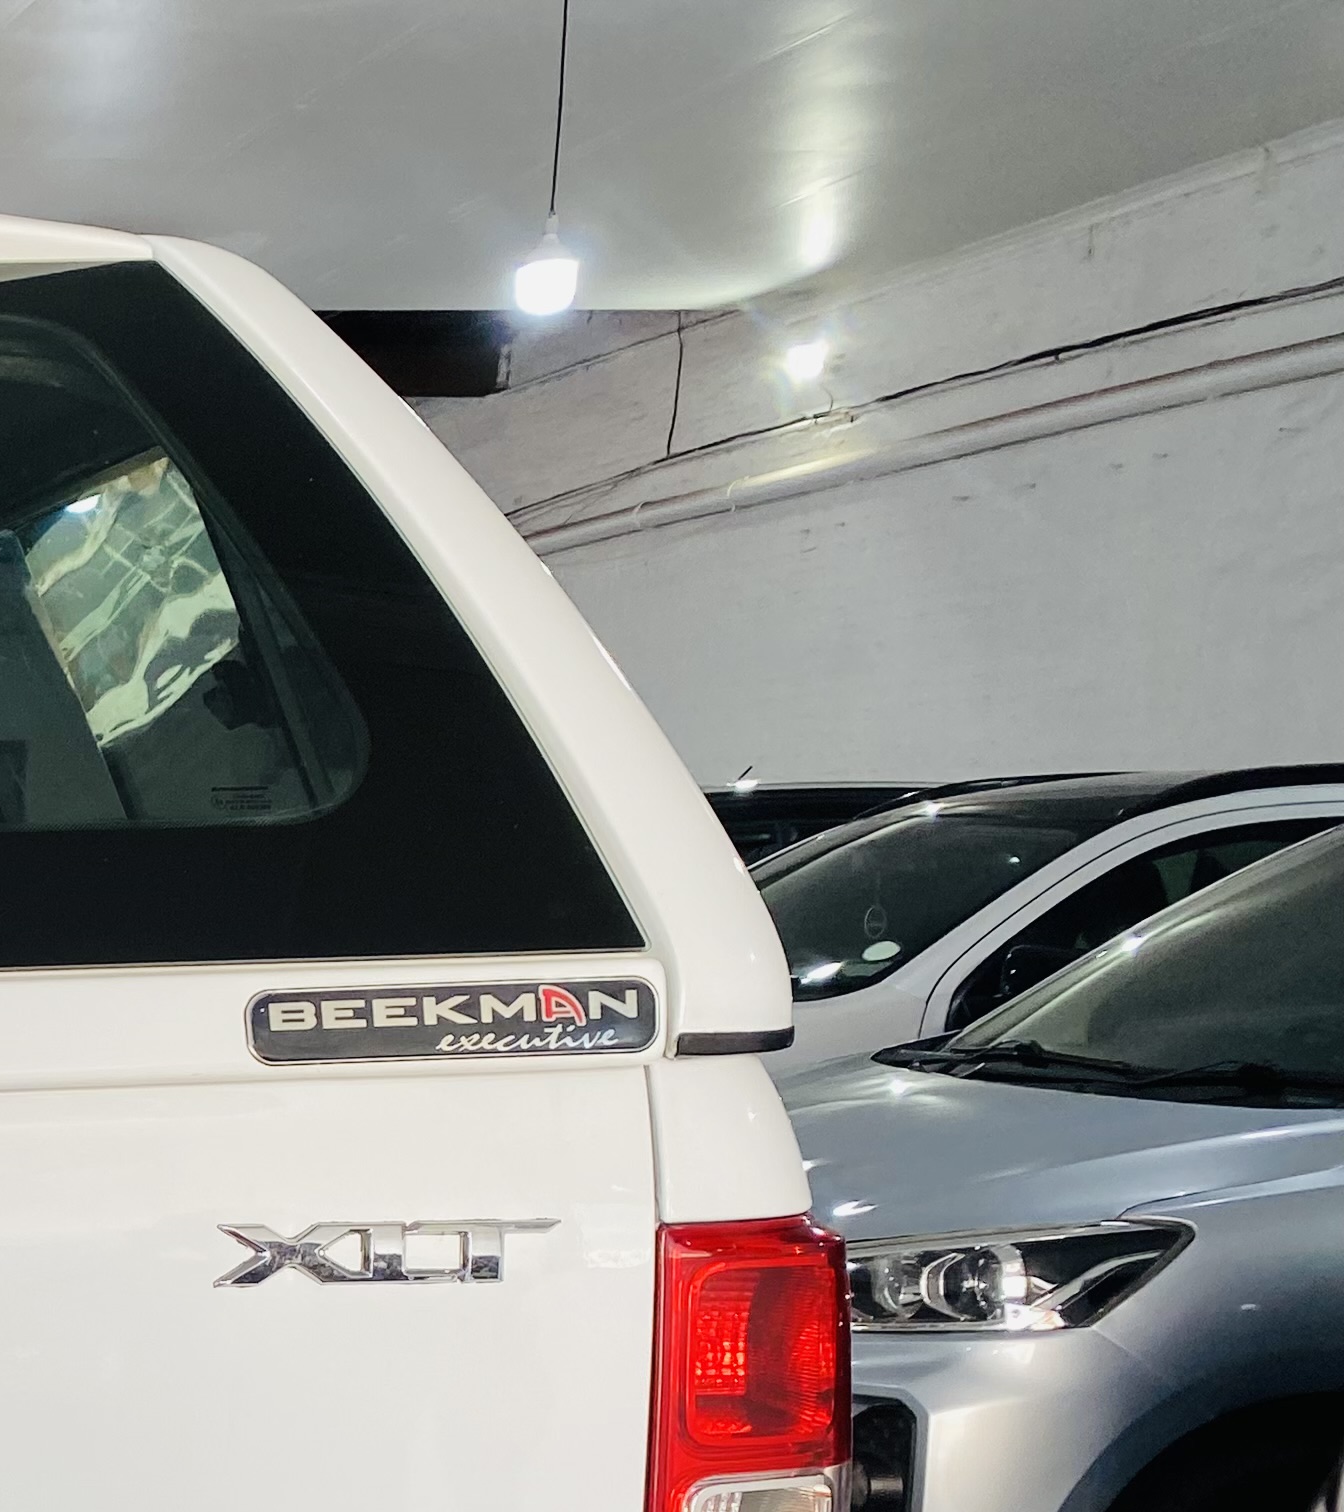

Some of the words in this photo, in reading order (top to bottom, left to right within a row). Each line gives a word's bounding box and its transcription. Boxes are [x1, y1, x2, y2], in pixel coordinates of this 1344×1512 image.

[268, 984, 639, 1032] BEEKMAN
[435, 1024, 619, 1052] executive
[213, 1219, 562, 1288] XLT
